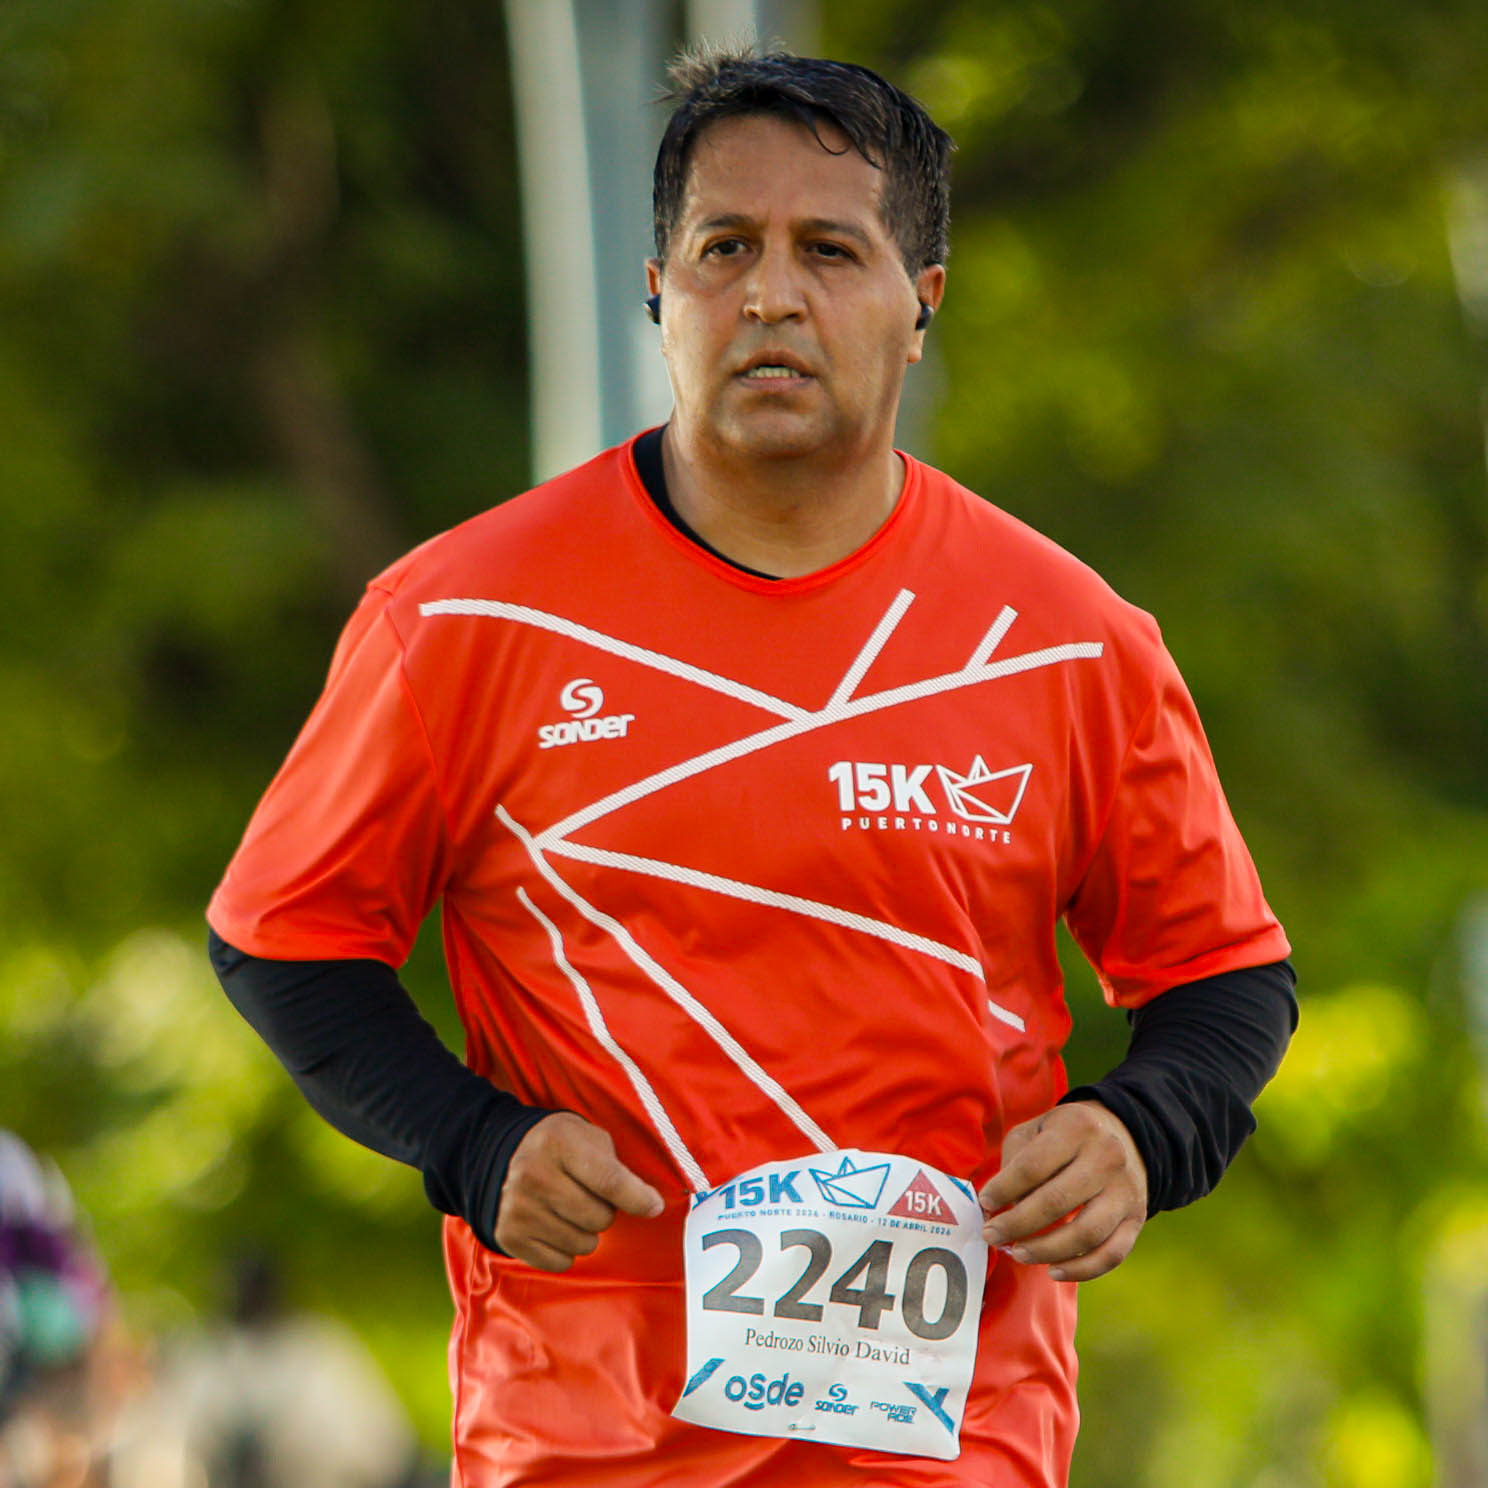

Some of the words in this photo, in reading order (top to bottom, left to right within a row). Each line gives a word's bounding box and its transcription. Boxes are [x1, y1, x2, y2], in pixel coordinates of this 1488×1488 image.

[828, 761, 937, 815] 15K
[718, 1170, 803, 1209] 15K
[905, 1189, 942, 1216] 15K
[759, 1208, 792, 1217] NORTE
[829, 1210, 868, 1224] ROSARIO
[890, 1219, 900, 1229] DE
[903, 1221, 928, 1233] ABRIL
[702, 1228, 968, 1341] 2240
[745, 1327, 804, 1352] Pedrozo
[807, 1335, 850, 1357] Silvio
[856, 1340, 910, 1366] David
[870, 1400, 917, 1417] POWER
